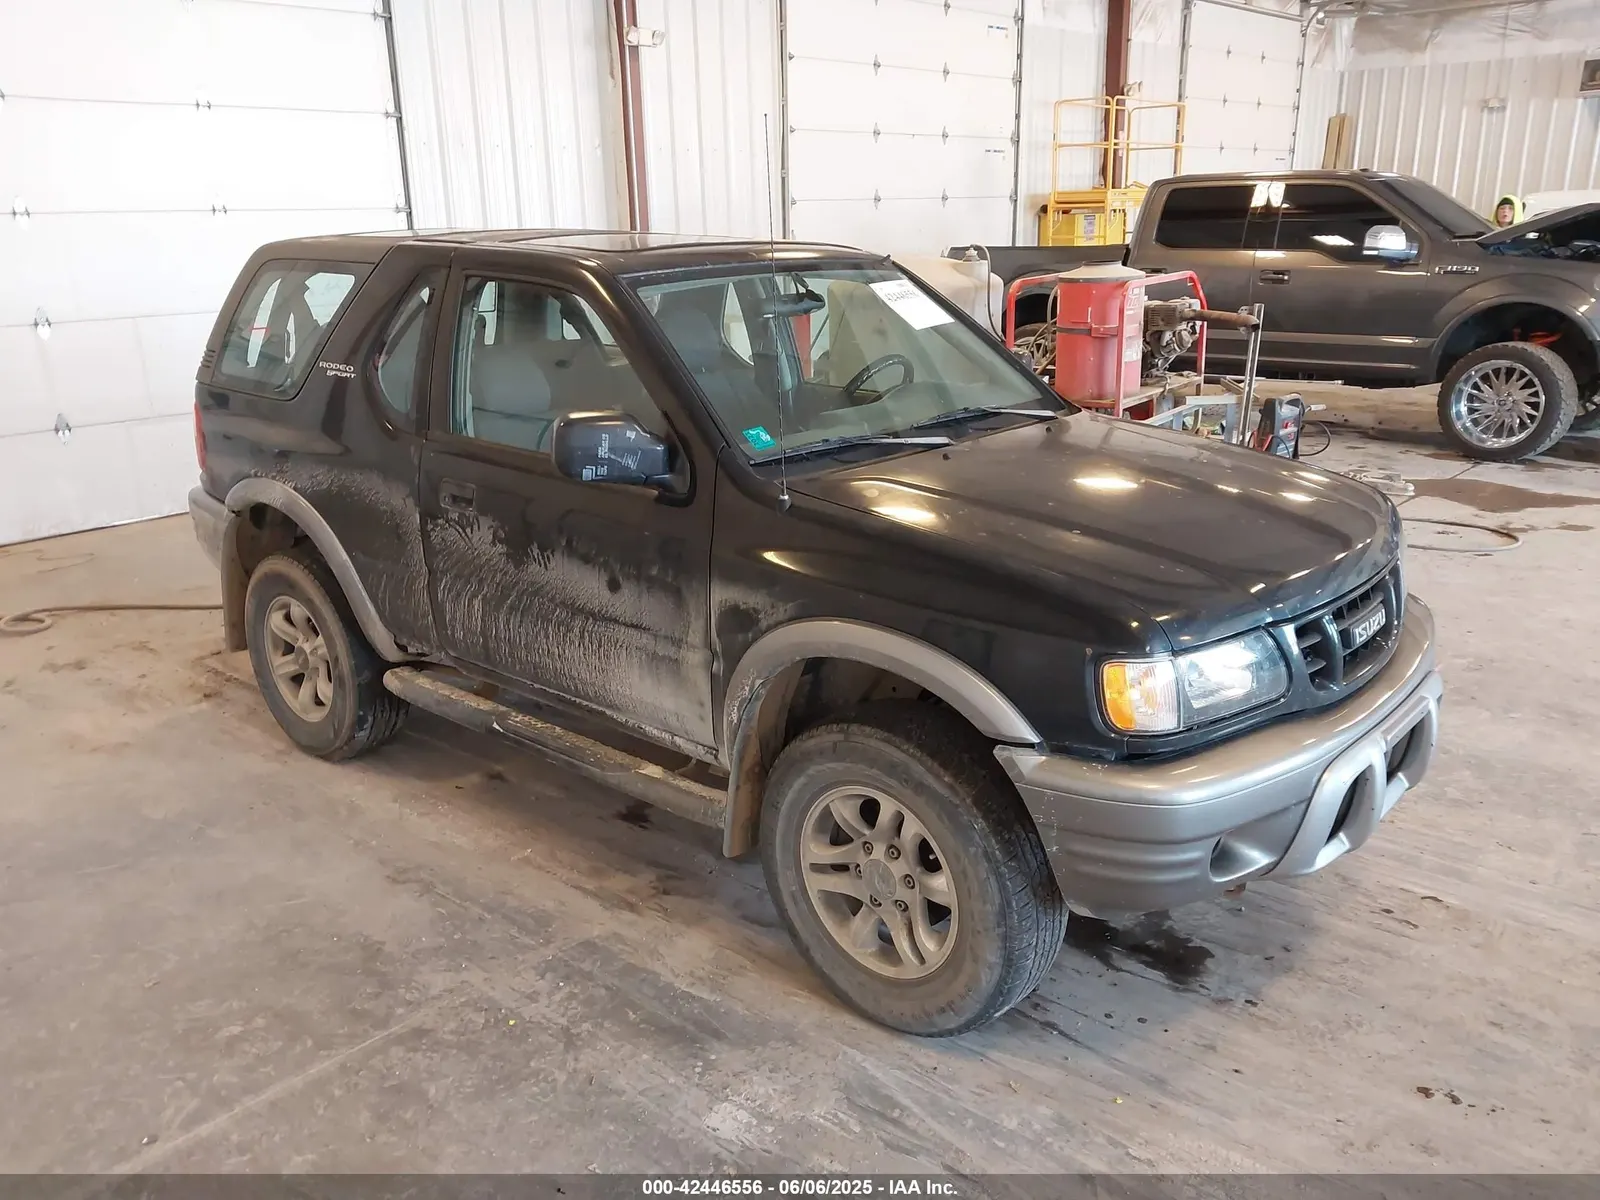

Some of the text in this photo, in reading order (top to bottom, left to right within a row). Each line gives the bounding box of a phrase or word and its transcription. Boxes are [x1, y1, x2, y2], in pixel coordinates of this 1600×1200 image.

[319, 361, 354, 372] RODEO
[326, 370, 356, 378] SPORT
[1354, 608, 1386, 644] ISUZU
